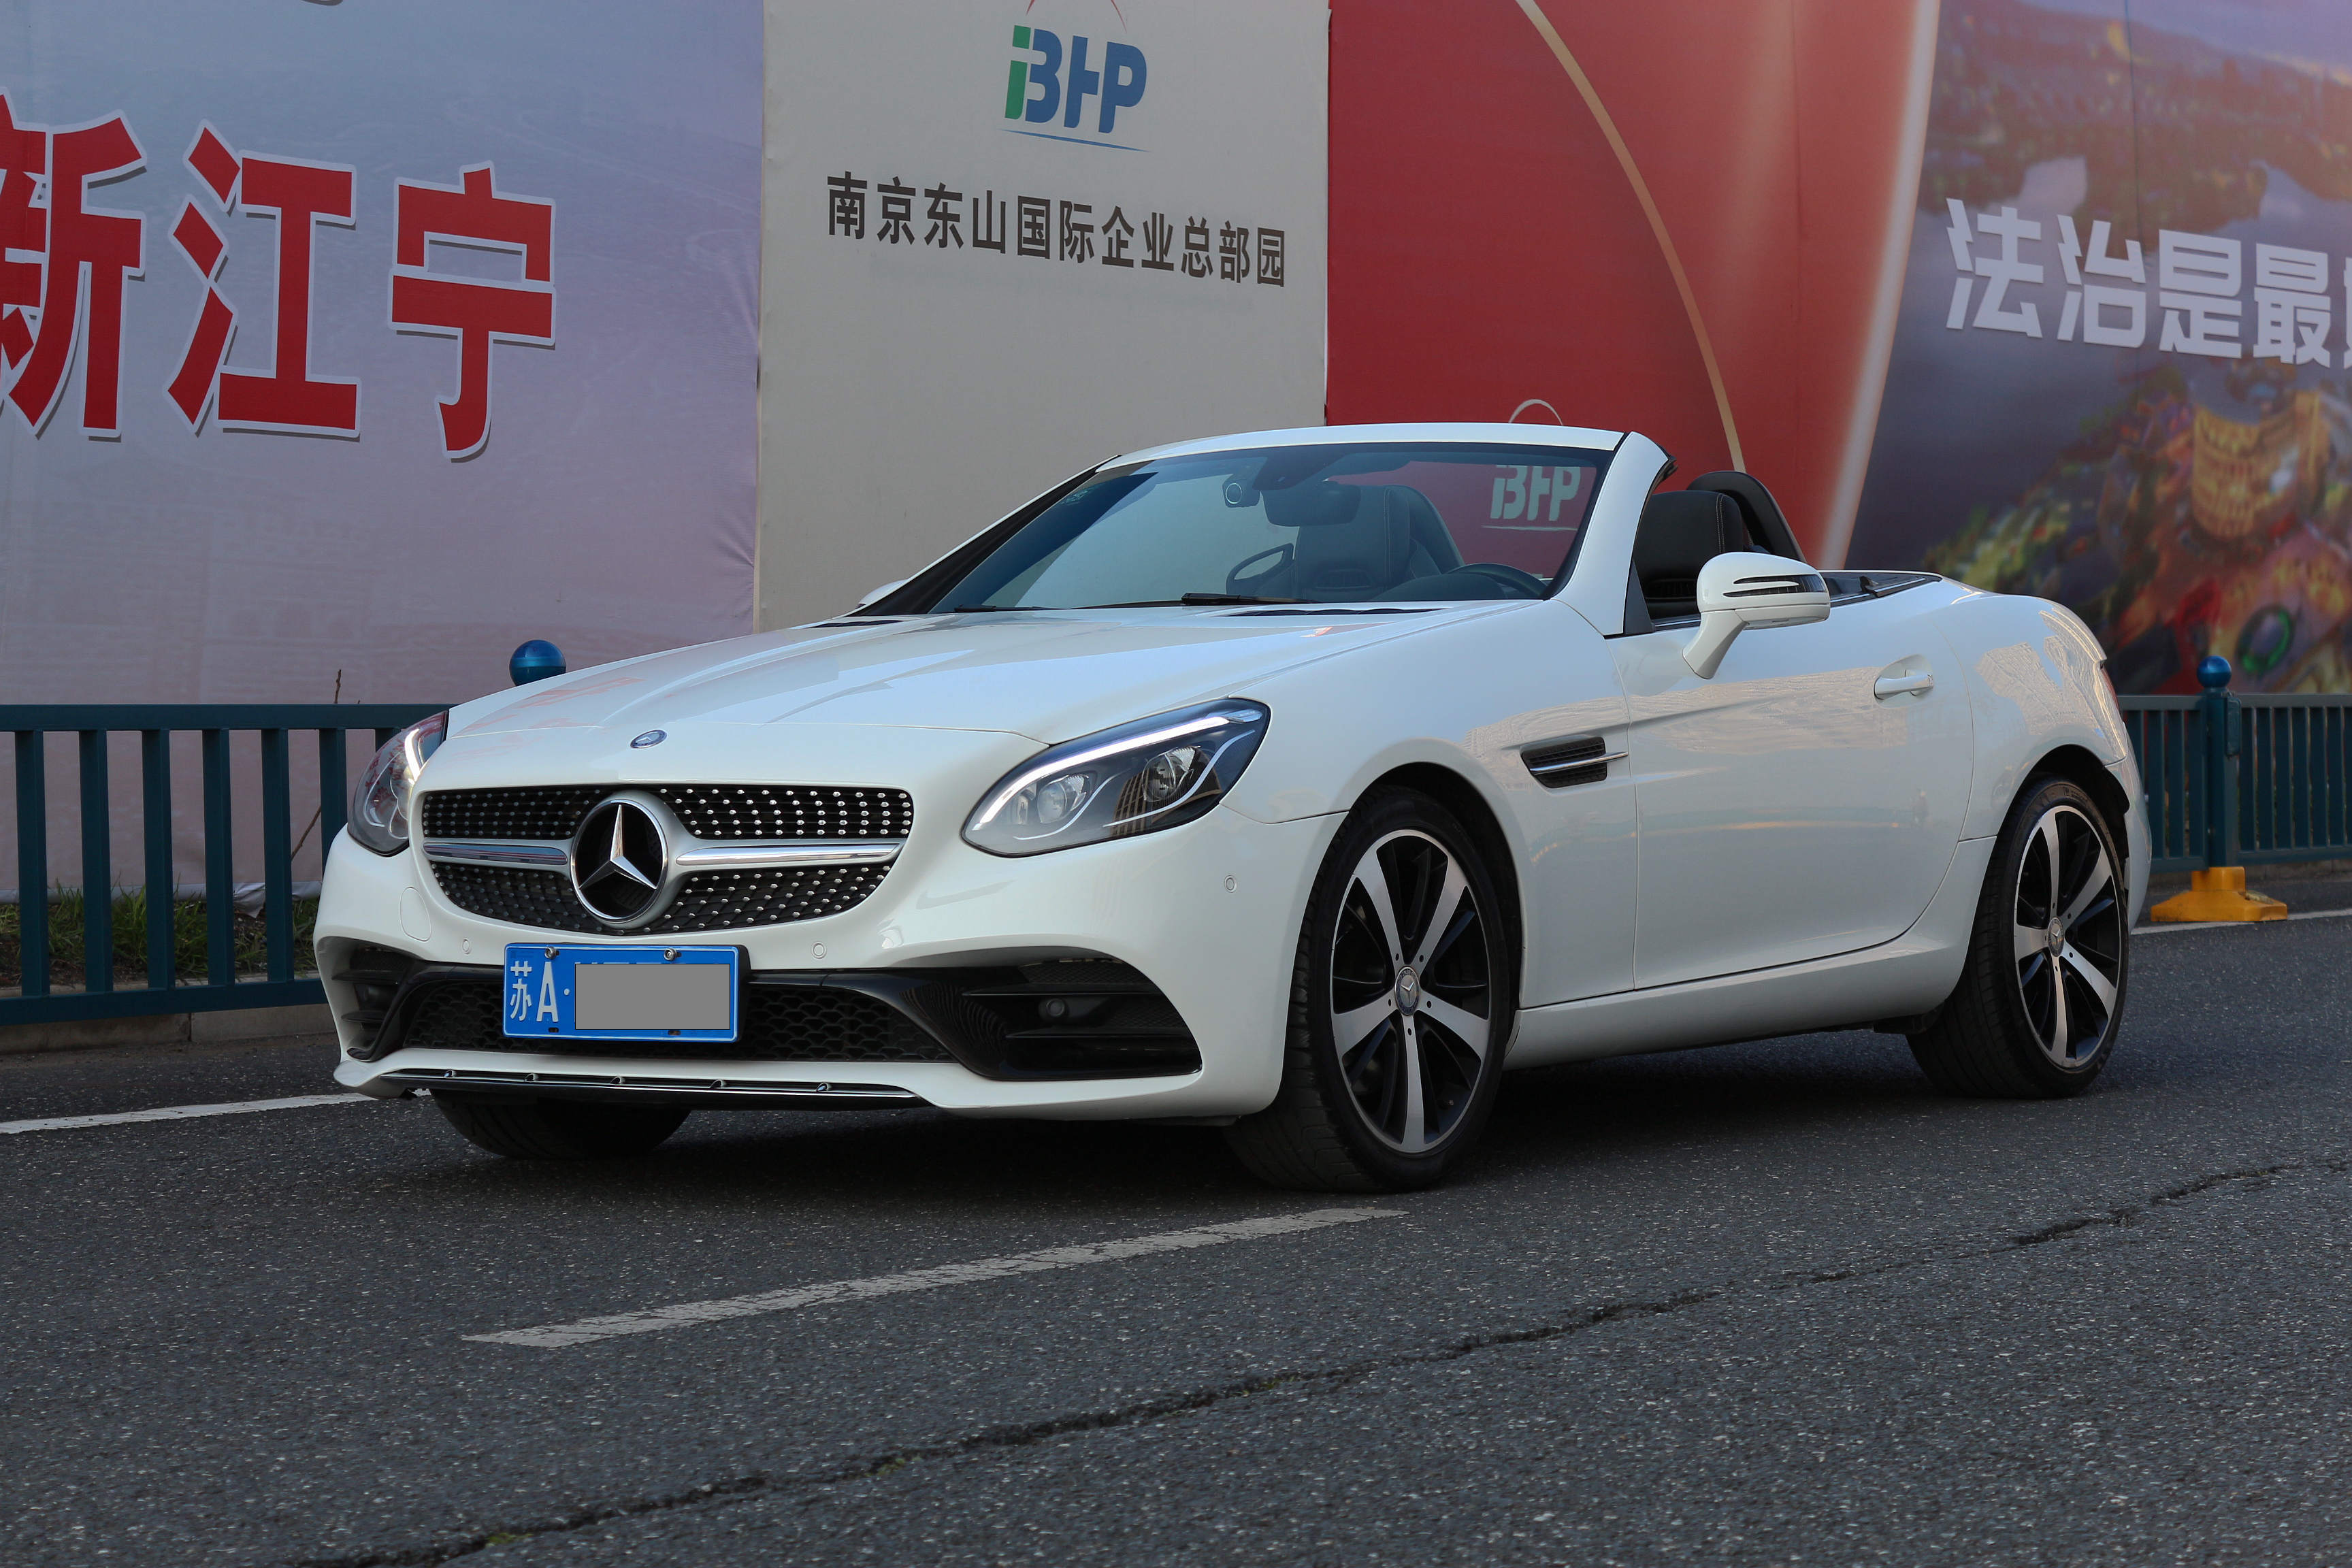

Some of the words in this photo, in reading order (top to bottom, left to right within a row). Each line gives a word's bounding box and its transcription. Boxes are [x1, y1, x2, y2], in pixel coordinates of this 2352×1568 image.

[0, 89, 555, 457] 新江宁
[827, 172, 1285, 287] 南京东山国际企业总部园
[1946, 197, 2352, 370] 法治是最
